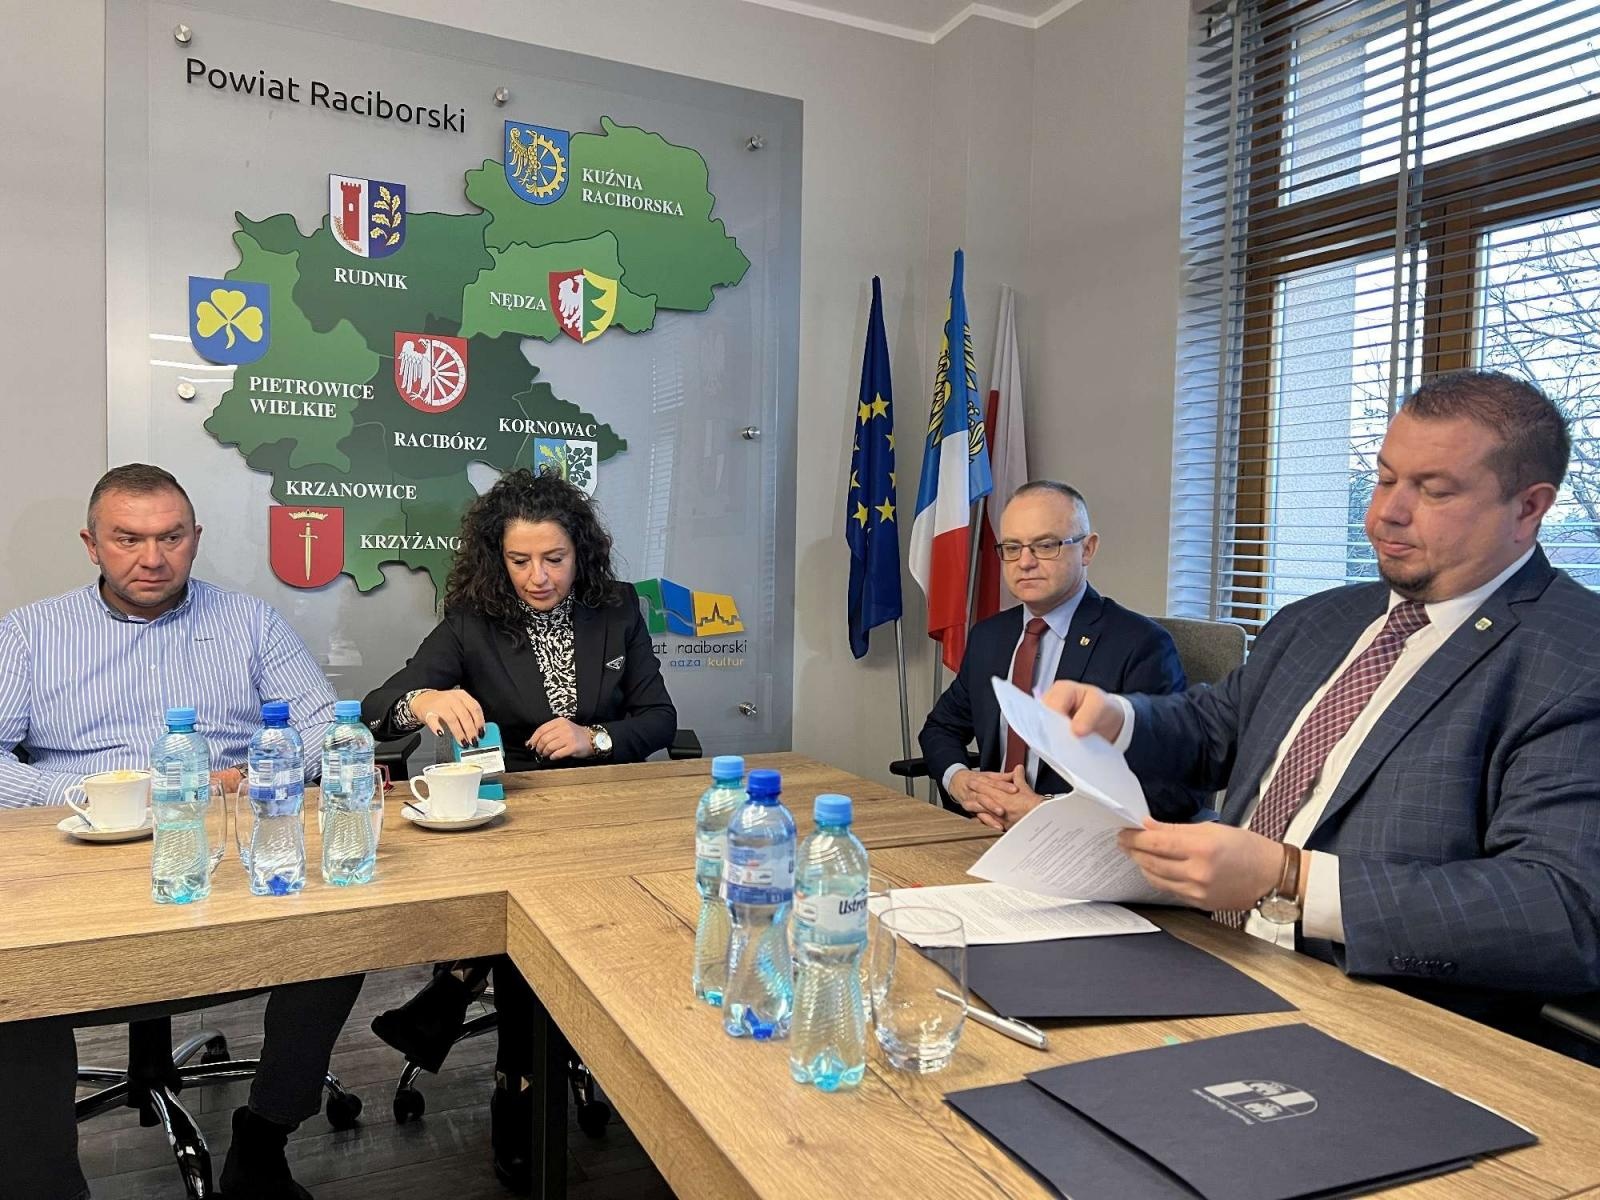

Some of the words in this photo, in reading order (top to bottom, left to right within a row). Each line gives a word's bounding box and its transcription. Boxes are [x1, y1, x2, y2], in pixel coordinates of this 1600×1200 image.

[187, 58, 300, 103] Powiat
[311, 81, 465, 133] Raciborski
[582, 168, 643, 191] KUŹNIA
[582, 188, 684, 216] RACIBORSKA
[334, 267, 408, 290] RUDNIK
[489, 291, 547, 311] NĘDZA
[249, 376, 375, 400] PIETROWICE
[249, 398, 337, 418] WIELKIE
[499, 418, 598, 438] KORNOWAC
[394, 431, 488, 451] RACIBÓRZ
[286, 480, 417, 500] KRZANOWICE
[360, 531, 462, 551] KRZYŻANO
[677, 639, 747, 655] raciborski
[839, 898, 867, 916] Ustro
